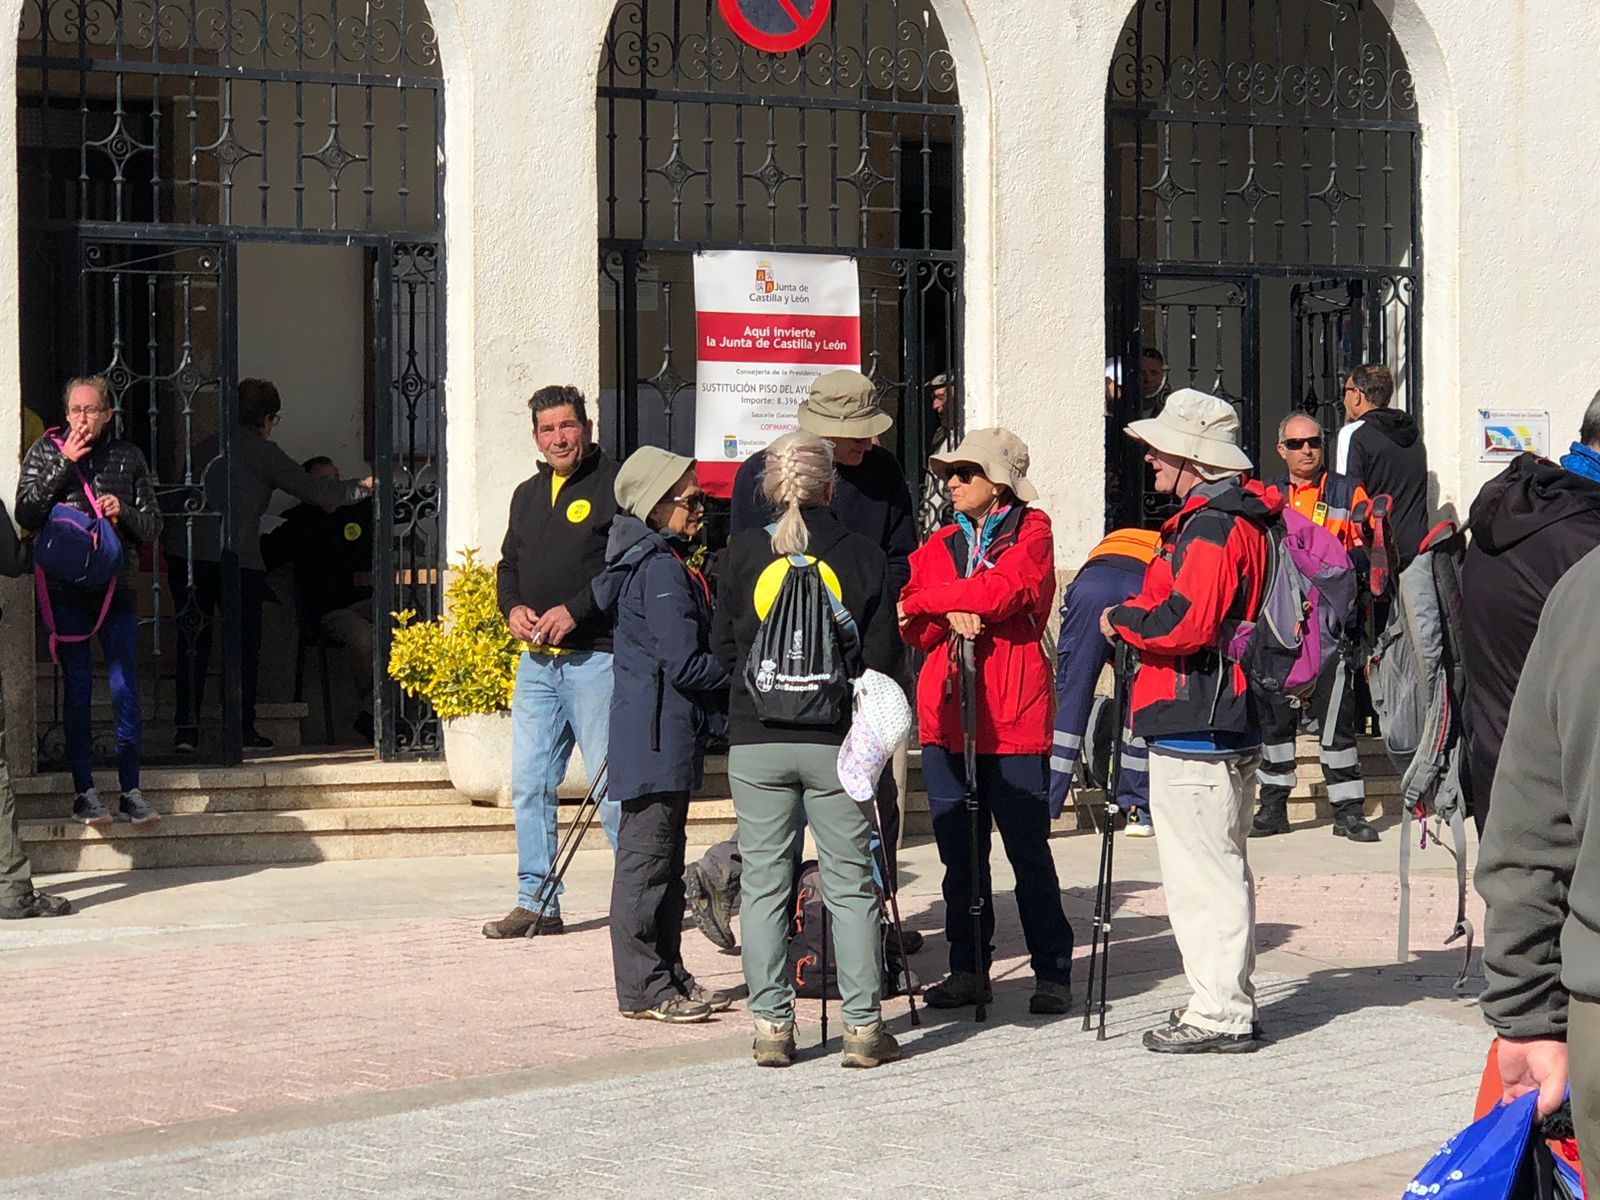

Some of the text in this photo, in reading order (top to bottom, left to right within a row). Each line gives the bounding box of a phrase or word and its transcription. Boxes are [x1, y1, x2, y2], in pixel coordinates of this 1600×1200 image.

[775, 282, 809, 292] Junta de
[749, 292, 810, 304] Castilla y León
[744, 326, 816, 338] Aquí invierte
[706, 336, 847, 352] la Junta de Castilla y León
[702, 382, 811, 394] SUSTITUCIÓN PISO DEL AYU
[741, 396, 774, 406] Importe:
[776, 674, 830, 682] Ayuntamiento
